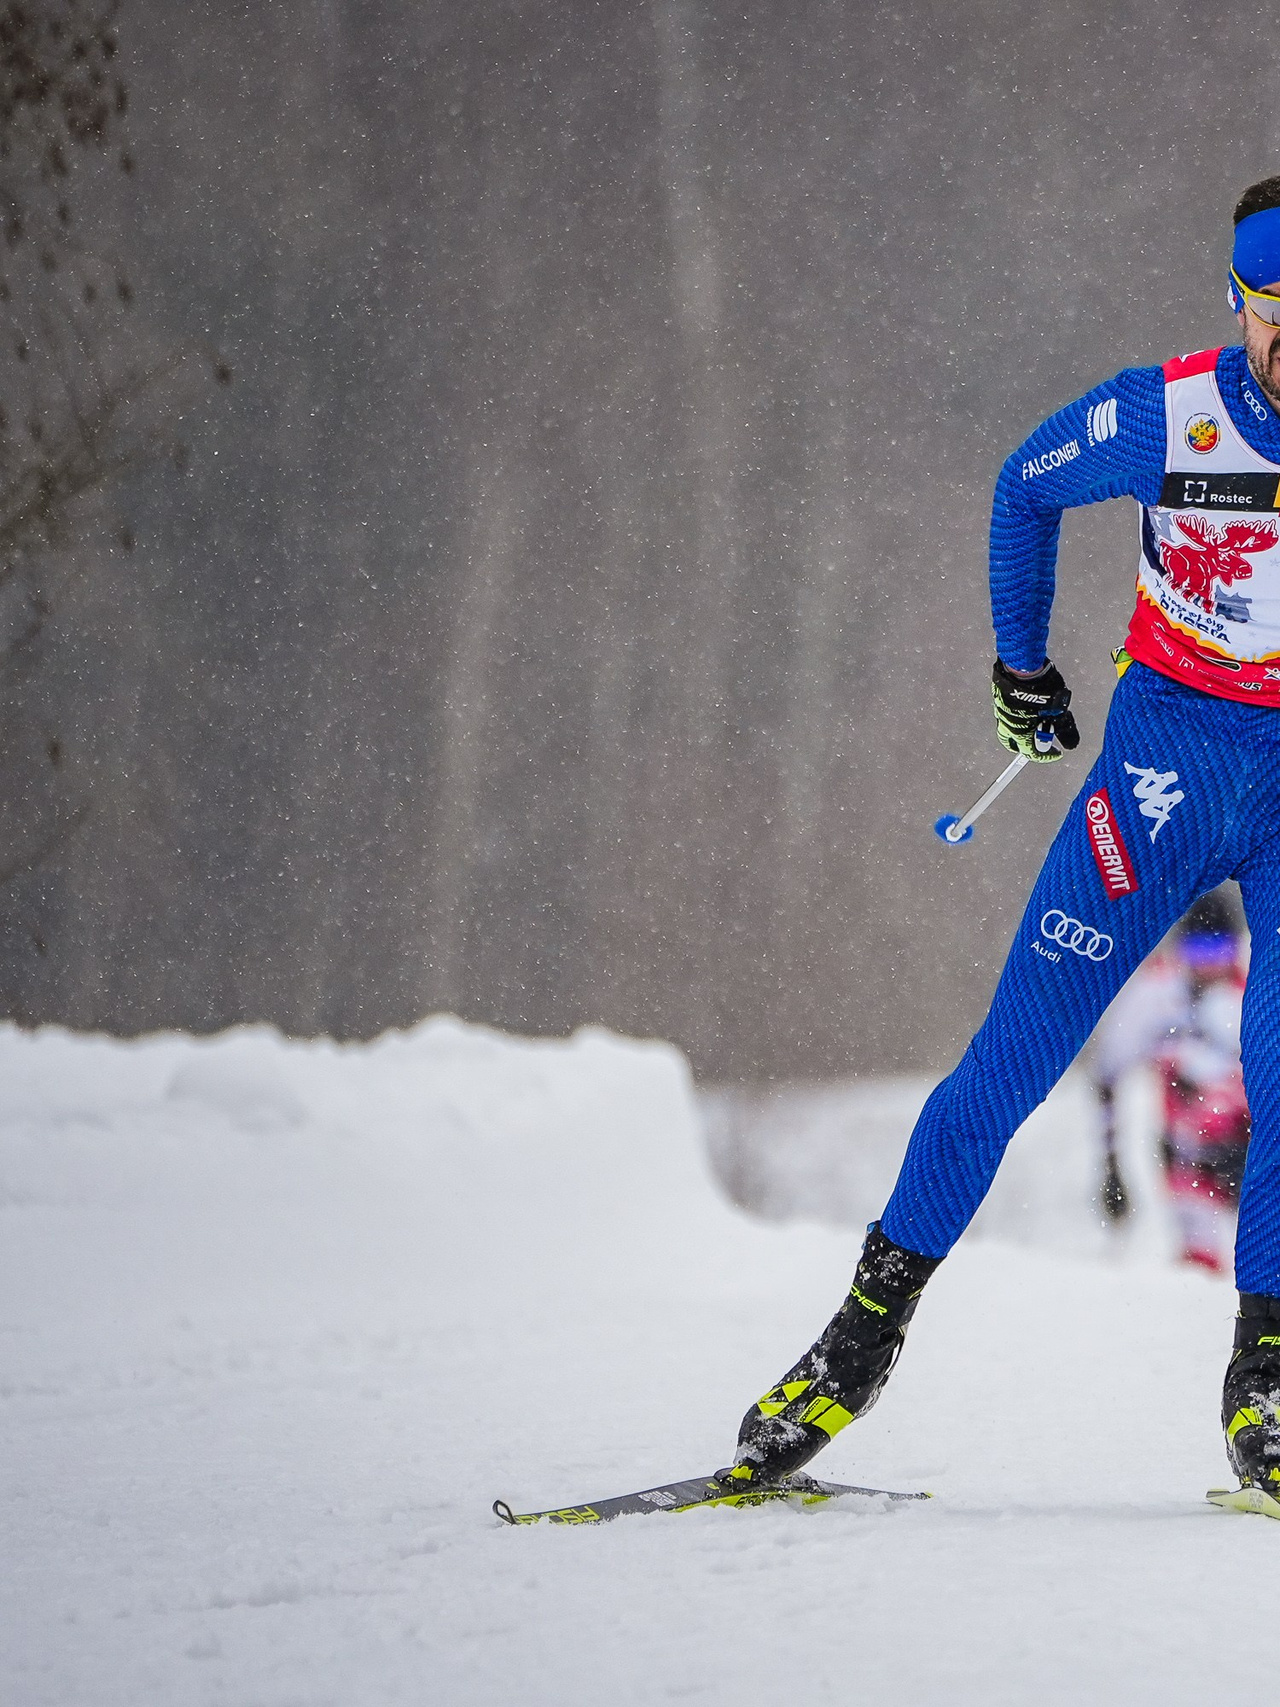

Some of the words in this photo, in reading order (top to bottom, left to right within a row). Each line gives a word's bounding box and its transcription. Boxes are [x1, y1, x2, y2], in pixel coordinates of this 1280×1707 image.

[1022, 438, 1081, 481] FALCONERI
[1210, 493, 1253, 505] Rostec
[1092, 821, 1131, 892] ENERVIT
[1030, 940, 1063, 965] Audi
